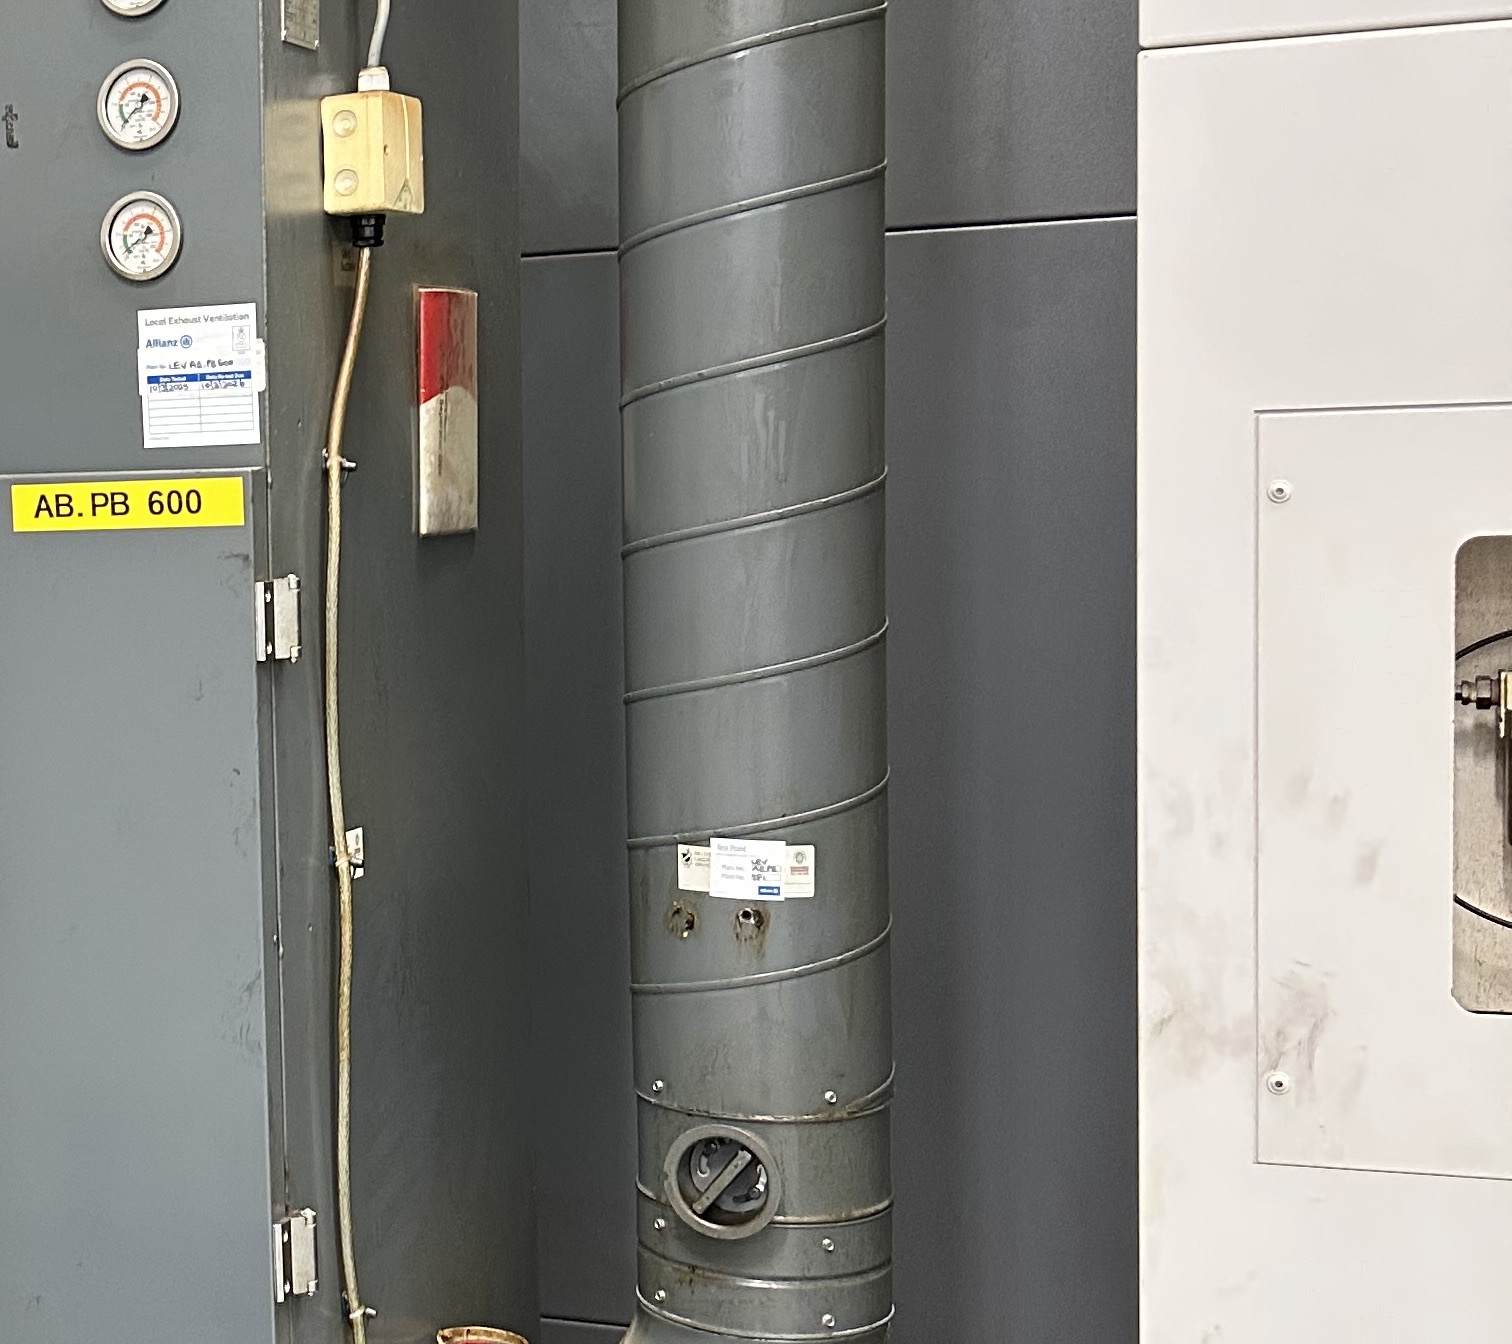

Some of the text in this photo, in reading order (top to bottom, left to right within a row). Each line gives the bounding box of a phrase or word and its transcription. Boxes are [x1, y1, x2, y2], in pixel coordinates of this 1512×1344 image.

[144, 312, 250, 327] Local Exhaust Ventilation
[145, 338, 178, 349] Allianz
[34, 489, 202, 519] AB.PB 600
